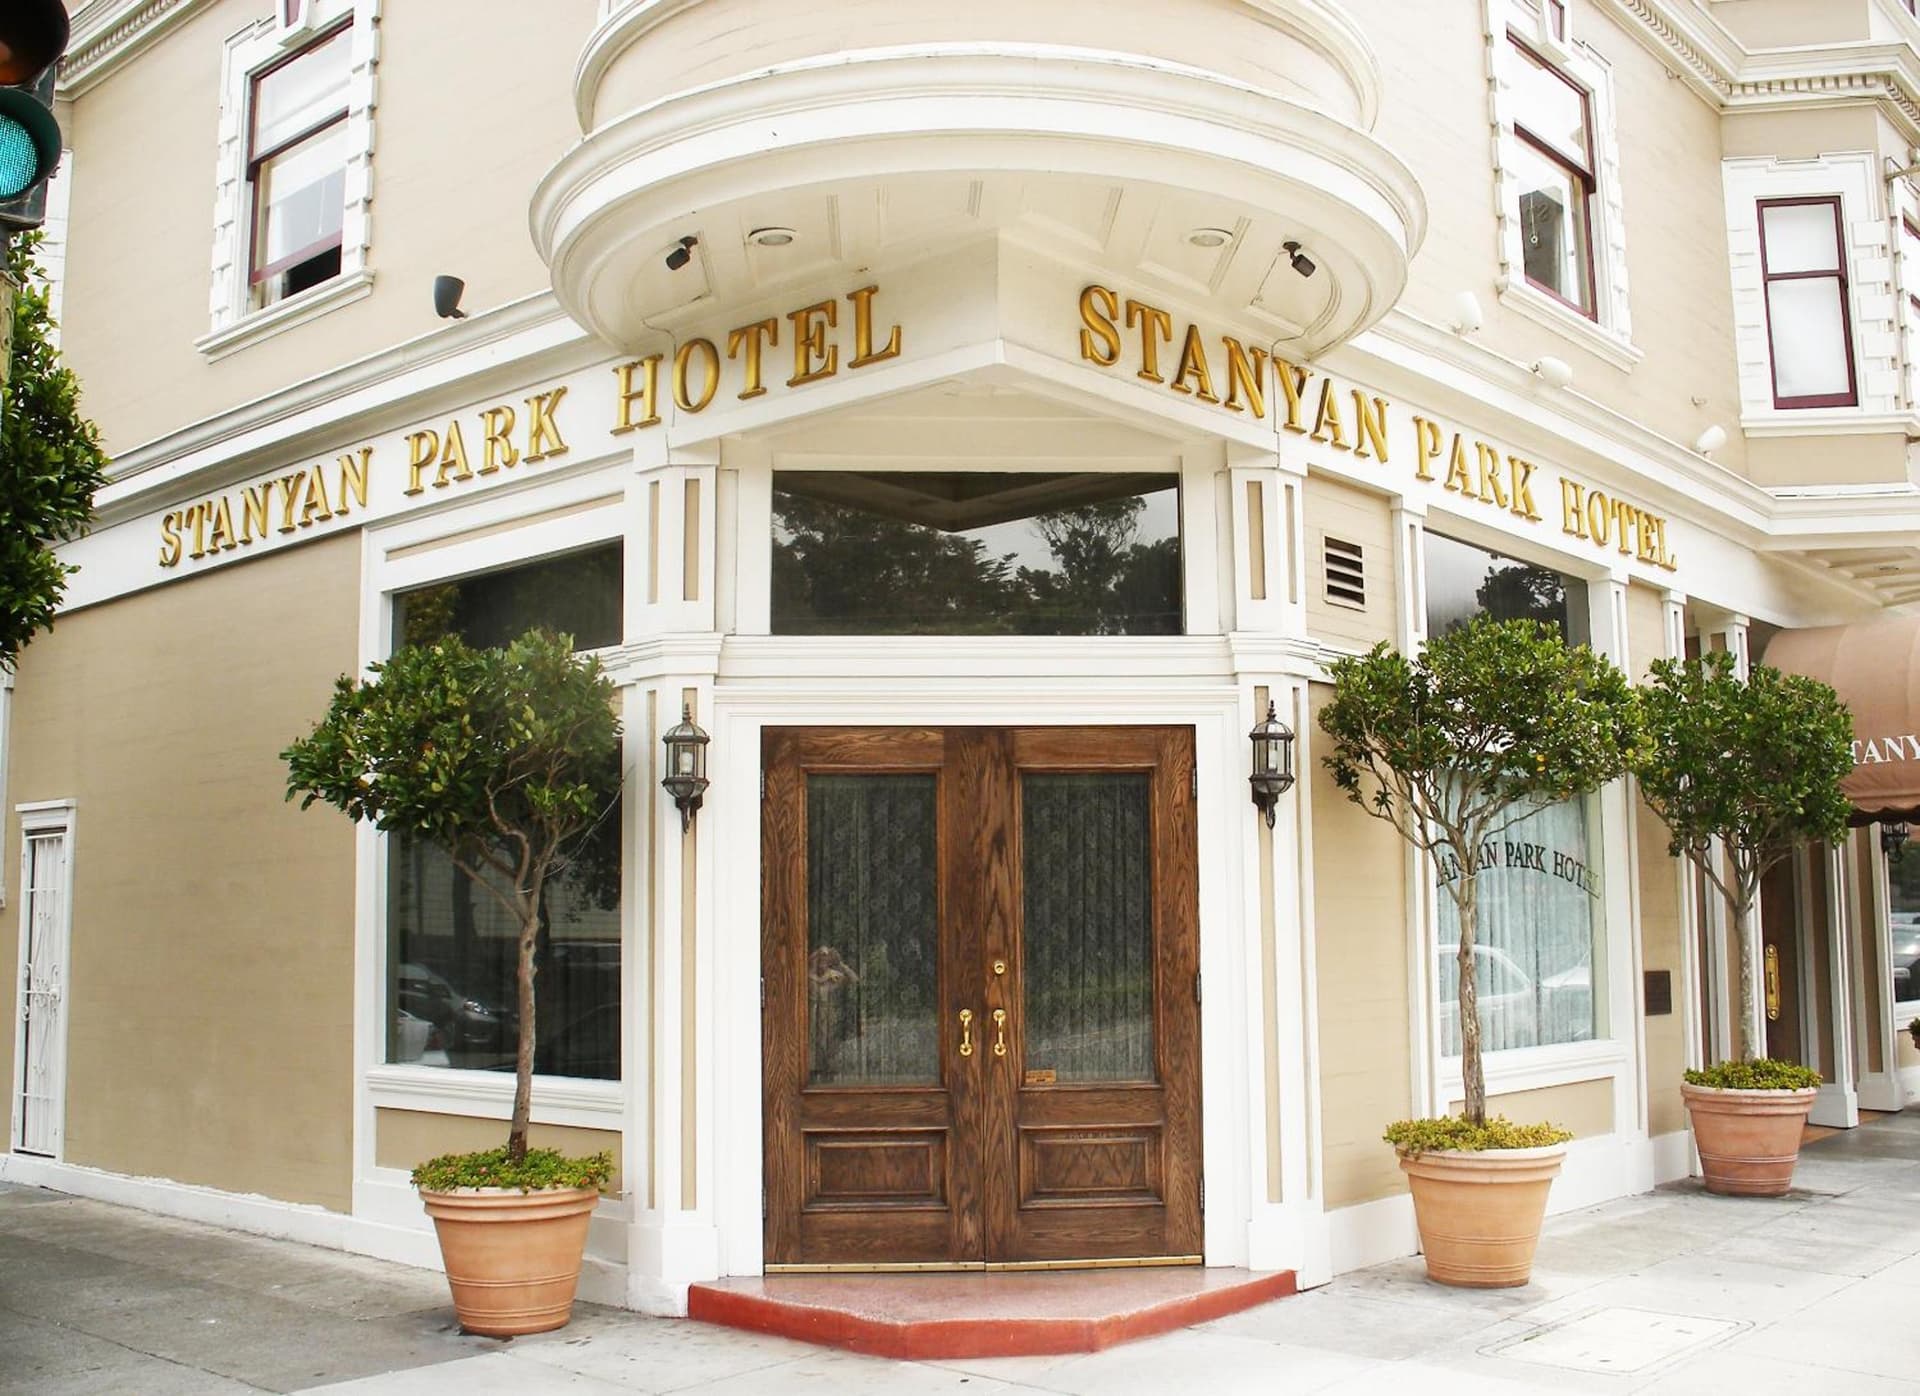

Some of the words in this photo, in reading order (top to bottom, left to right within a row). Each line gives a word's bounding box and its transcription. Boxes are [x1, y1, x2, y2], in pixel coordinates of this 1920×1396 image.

[159, 447, 373, 567] STANYAN
[403, 386, 569, 496] PARK
[610, 285, 902, 435] HOTEL
[1080, 285, 1390, 463] STANYAN
[1412, 415, 1543, 521] PARK
[1559, 476, 1678, 572] HOTEL
[1505, 841, 1547, 874] PARK
